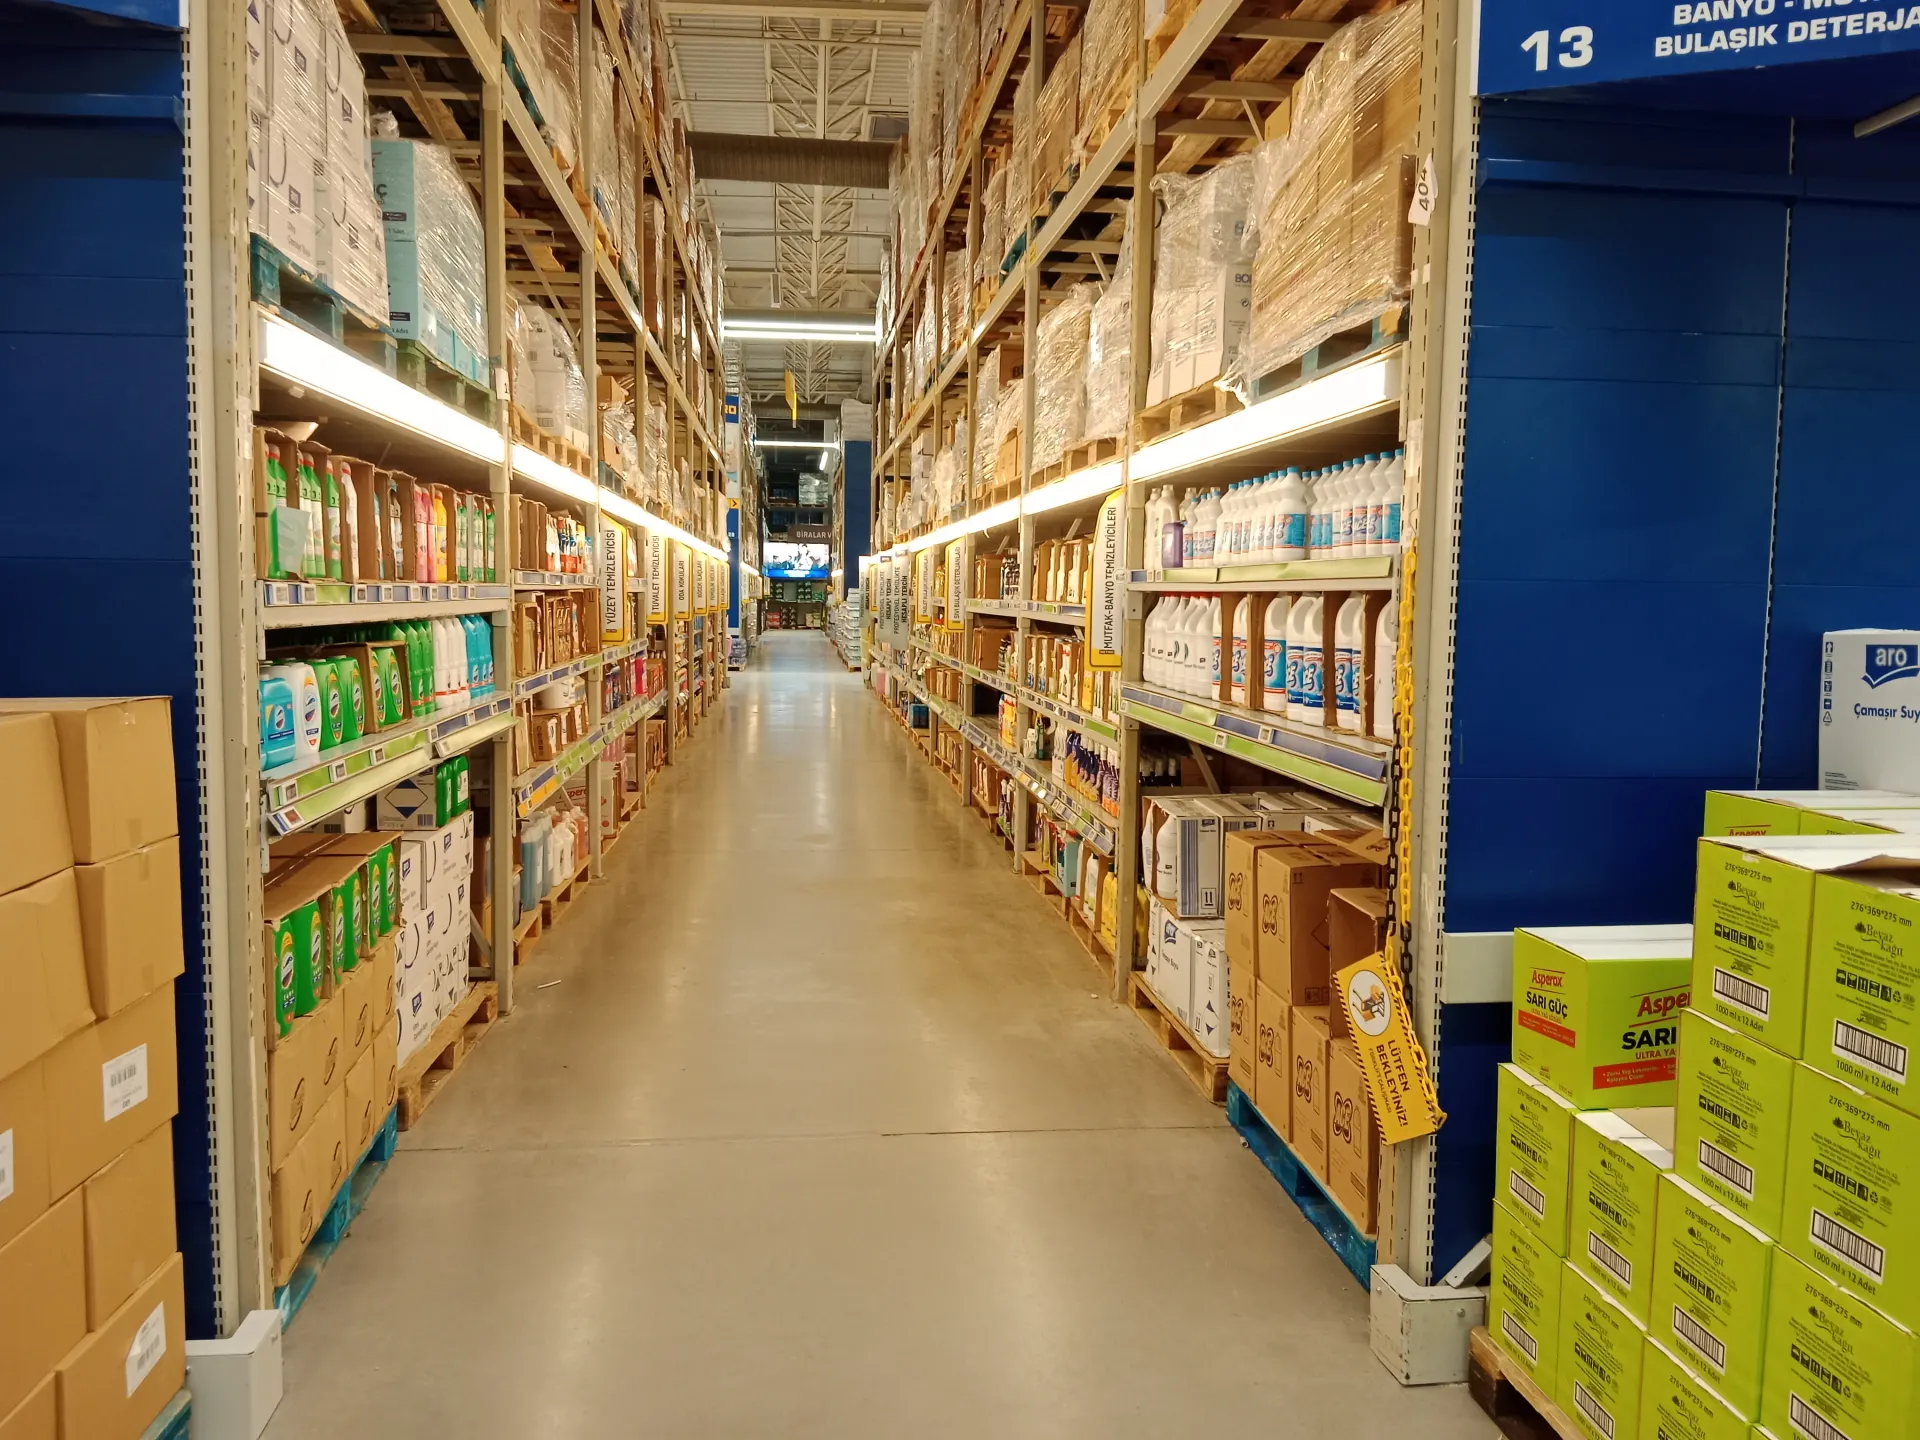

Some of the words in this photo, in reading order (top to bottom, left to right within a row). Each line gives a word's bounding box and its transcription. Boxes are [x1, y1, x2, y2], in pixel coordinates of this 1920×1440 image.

[1673, 0, 1775, 26] BANYO
[1655, 24, 1778, 57] BULAŞIK
[1787, 6, 1920, 43] DETERJA
[1520, 26, 1594, 72] 13
[1417, 167, 1430, 212] 404
[796, 529, 825, 539] BİRALAR
[1104, 507, 1117, 579] TEMİZLEYİCİLERİ
[604, 529, 616, 592] TEMİZLEYİCİSİ
[651, 535, 660, 582] TEMİZLEYİCİSİ
[605, 595, 616, 624] YÜZEY
[652, 584, 660, 611] TUVALET
[1103, 580, 1115, 649] MUTFAK-BANYO
[1874, 647, 1908, 667] aro
[1853, 702, 1898, 721] Çamaşır
[1761, 875, 1773, 884] mm
[1898, 916, 1913, 928] mm
[1531, 969, 1563, 988] Asperox
[1526, 991, 1547, 1010] SARI
[1548, 997, 1568, 1020] GÜÇ
[1715, 1003, 1729, 1017] 1000
[1742, 1015, 1750, 1026] 12
[1749, 1019, 1764, 1033] Adet
[1621, 1026, 1677, 1051] SARI
[1387, 1039, 1411, 1092] LÜTFEN
[1635, 1050, 1662, 1060] ULTRA
[1376, 1043, 1409, 1127] BEKLEYİNİZ!
[1836, 1059, 1853, 1074] 1000
[1854, 1070, 1864, 1079] ml
[1871, 1075, 1880, 1087] 12
[1880, 1081, 1900, 1096] Adet
[1876, 1119, 1891, 1132] mm
[1700, 1173, 1715, 1188] 1000
[1727, 1189, 1735, 1202] 12
[1734, 1195, 1749, 1211] Adet
[1720, 1231, 1732, 1244] mm
[1813, 1248, 1830, 1266] 1000
[1830, 1261, 1841, 1275] ml
[1848, 1270, 1857, 1284] 12
[1857, 1275, 1876, 1296] Adet
[1849, 1312, 1863, 1329] mm
